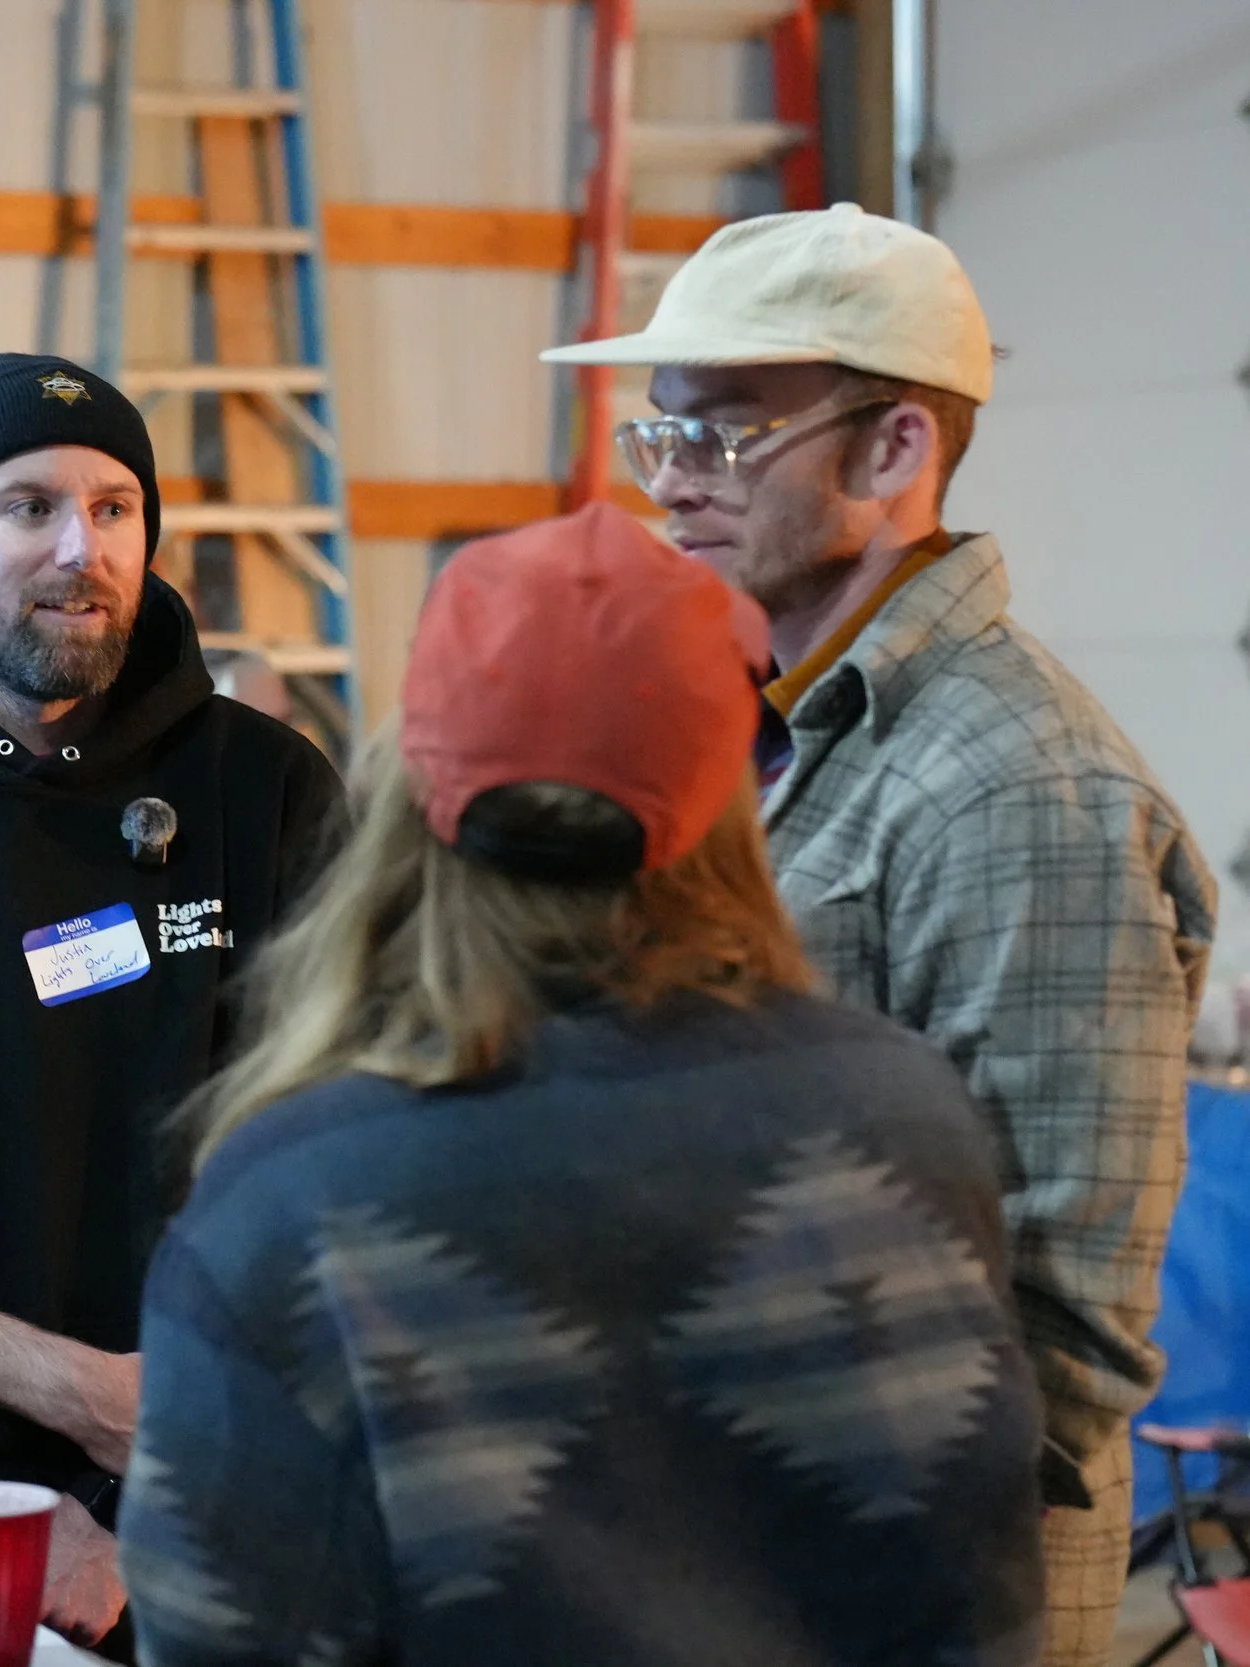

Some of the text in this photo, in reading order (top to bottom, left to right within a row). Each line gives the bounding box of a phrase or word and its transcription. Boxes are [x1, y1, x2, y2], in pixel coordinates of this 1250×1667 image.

[157, 898, 223, 924] Lights
[56, 917, 92, 936] Hello
[158, 920, 202, 937] Over
[50, 943, 94, 967] Justin
[41, 949, 115, 989] Lights Over
